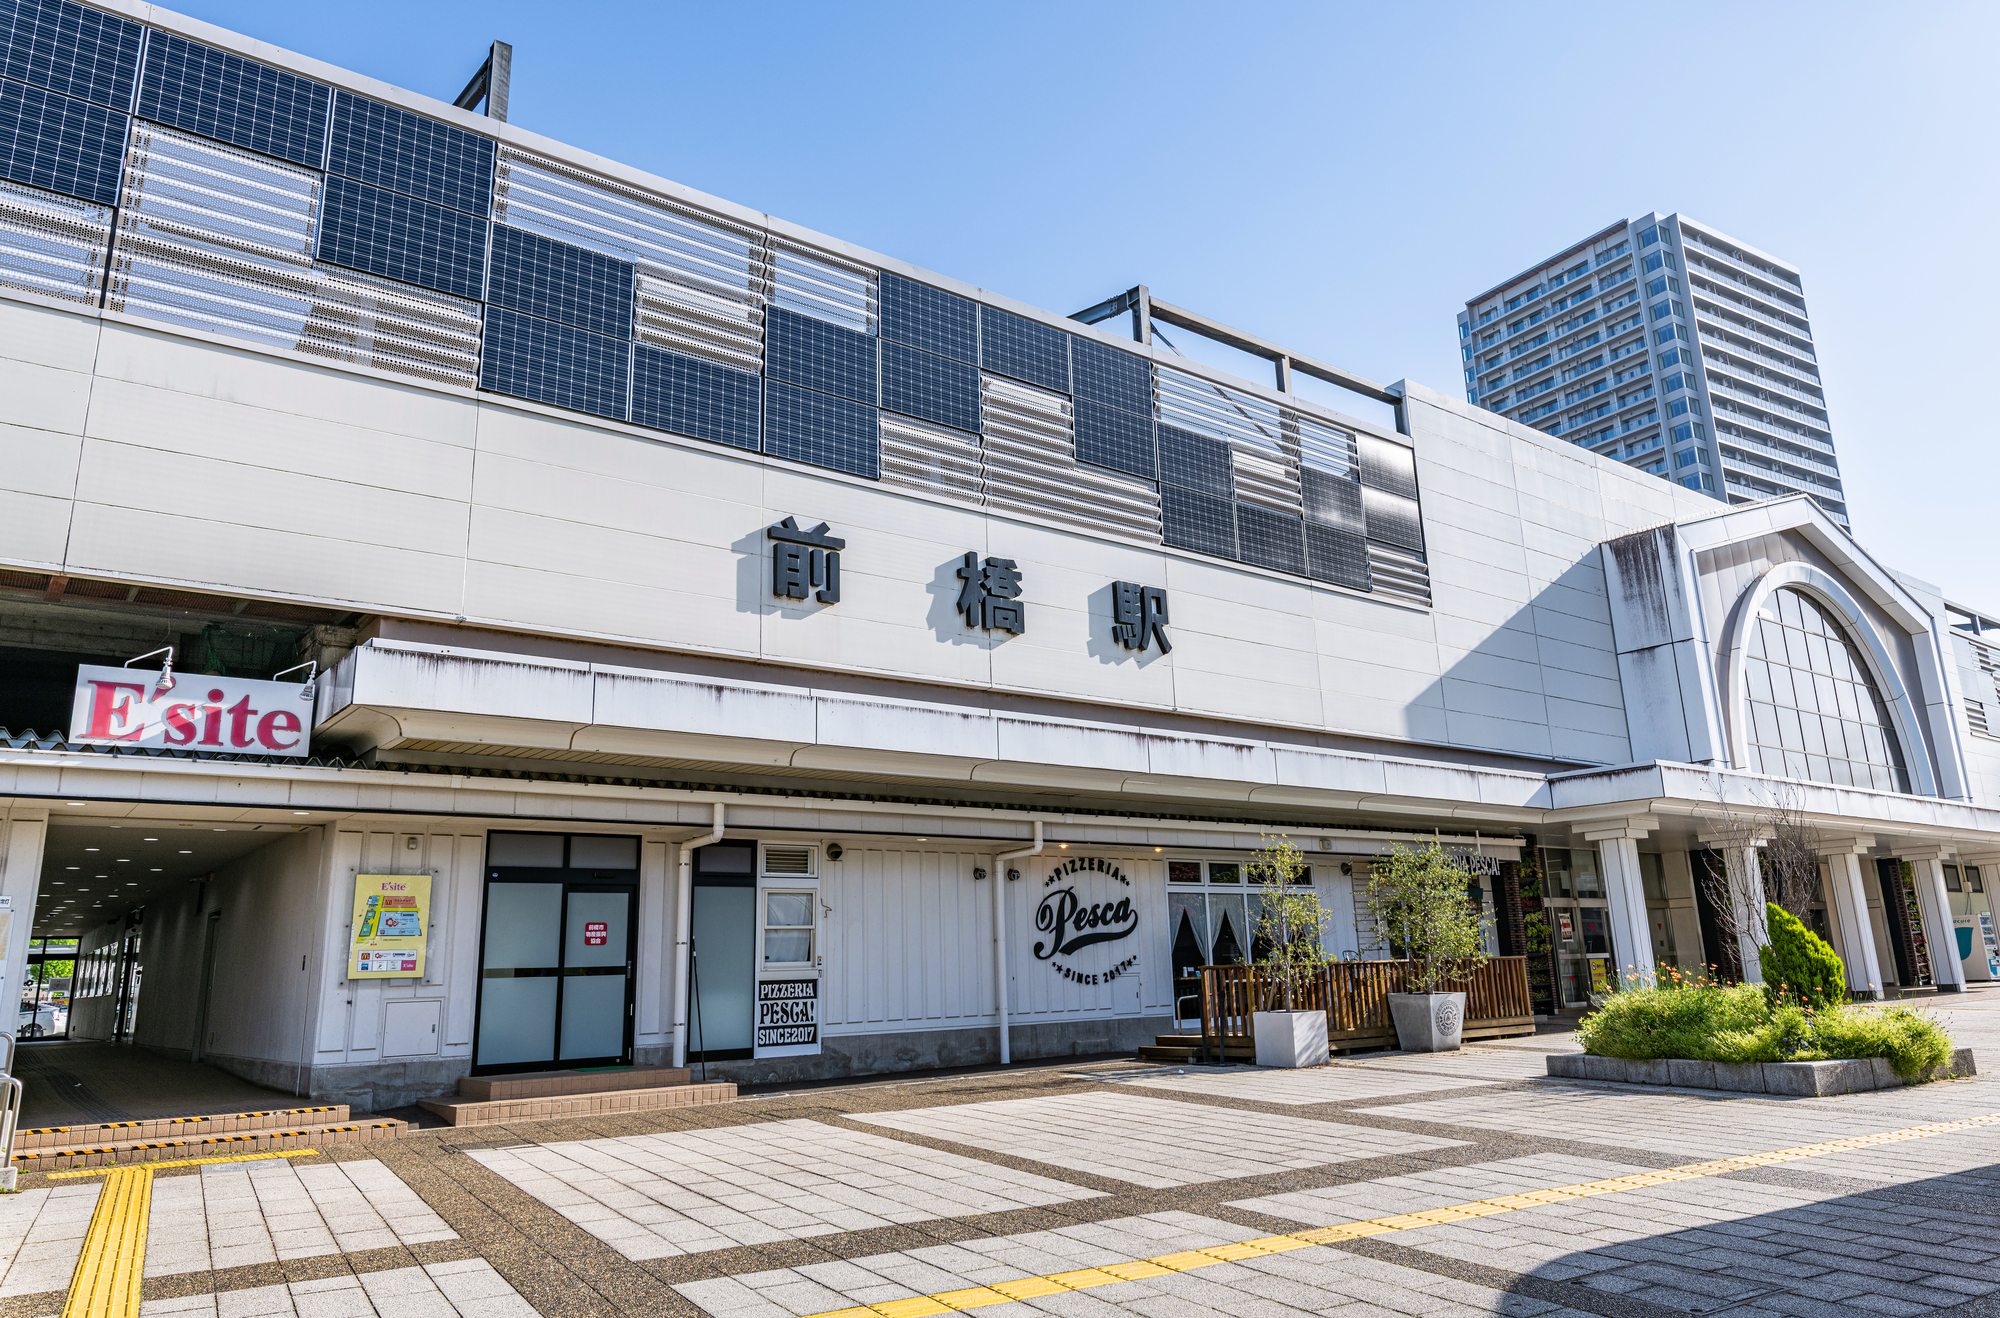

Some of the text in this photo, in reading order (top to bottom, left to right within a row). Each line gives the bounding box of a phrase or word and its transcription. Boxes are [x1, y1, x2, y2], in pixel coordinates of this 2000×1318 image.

[767, 515, 1172, 655] 前橋駅
[80, 676, 301, 750] E'site
[1053, 858, 1120, 881] PIZZERIA
[1469, 856, 1501, 876] PESCA!
[381, 882, 406, 891] E'site
[1033, 886, 1138, 960] Pesca
[1064, 961, 1128, 985] SINCE 2017
[760, 982, 815, 999] PIZZERIA
[759, 1001, 815, 1025] PESCA!
[758, 1027, 815, 1046] SINCE2017
